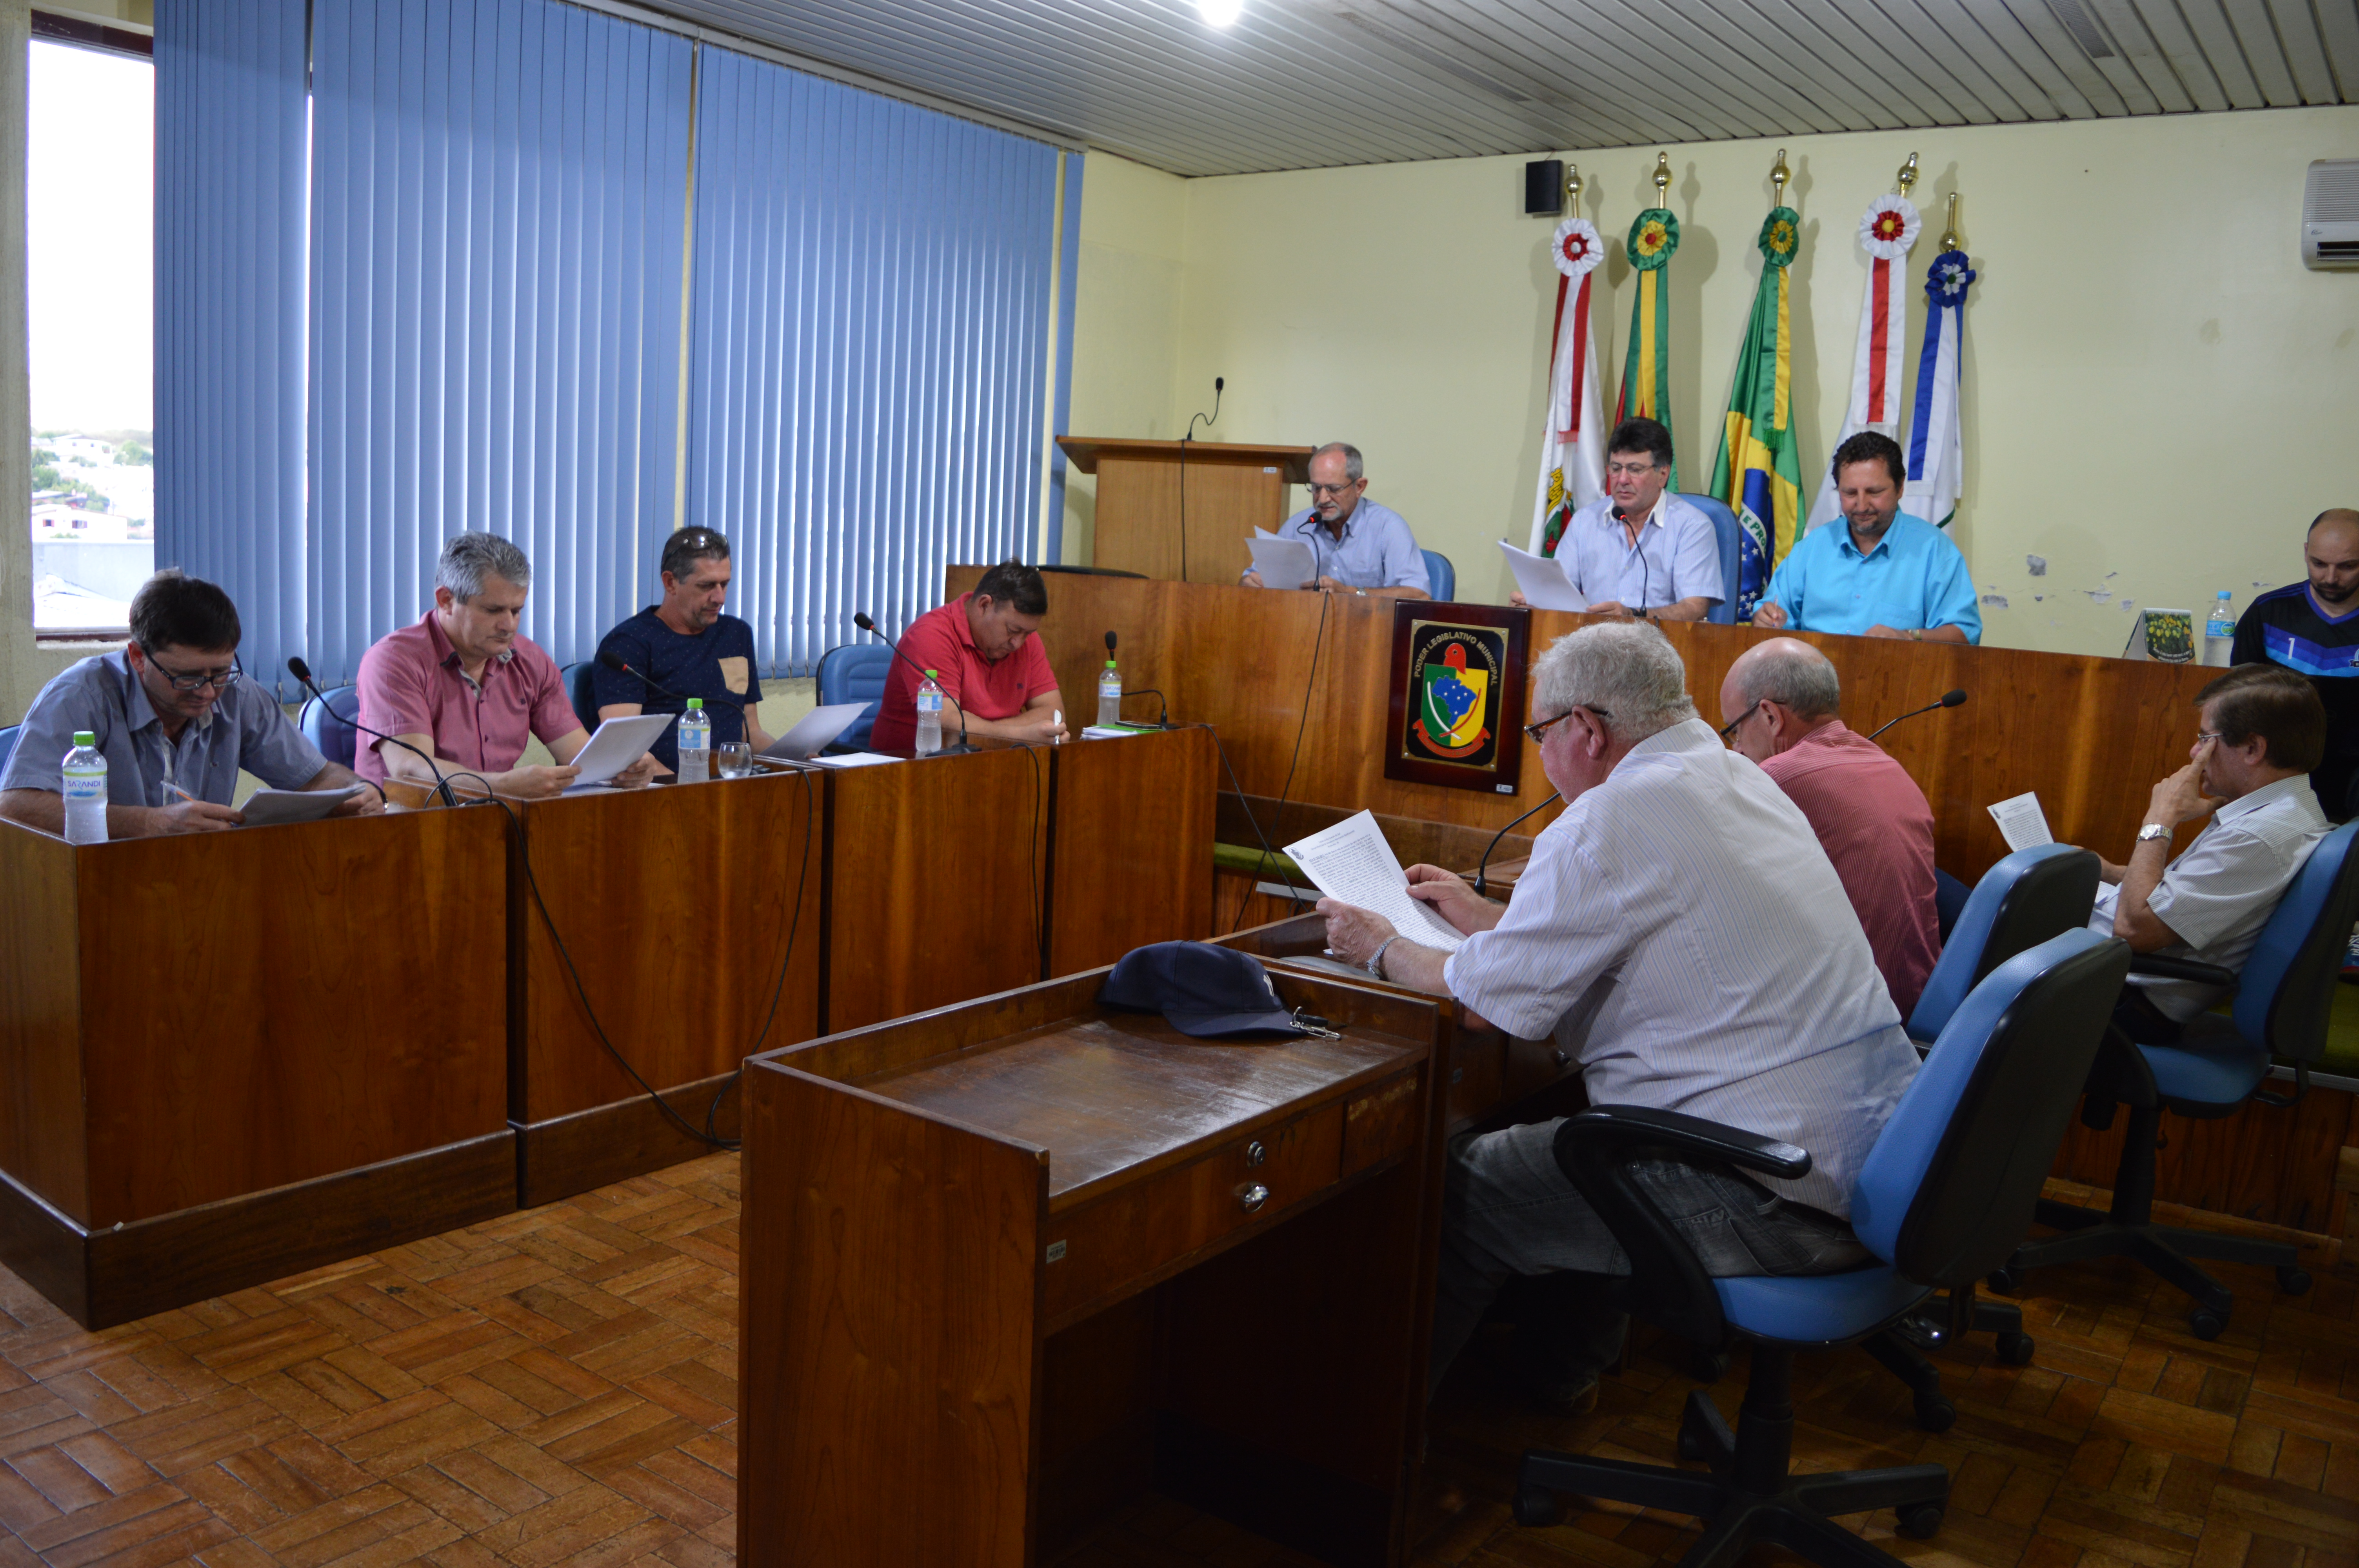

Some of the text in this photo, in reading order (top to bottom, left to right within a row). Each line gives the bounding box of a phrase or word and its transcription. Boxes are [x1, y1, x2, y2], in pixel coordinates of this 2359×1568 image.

[1743, 515, 1766, 548] E PRO
[1414, 632, 1498, 686] PODER LEGISLATIVO MUNICIPAL
[2288, 637, 2295, 659] 1
[68, 780, 101, 790] SARANDI
